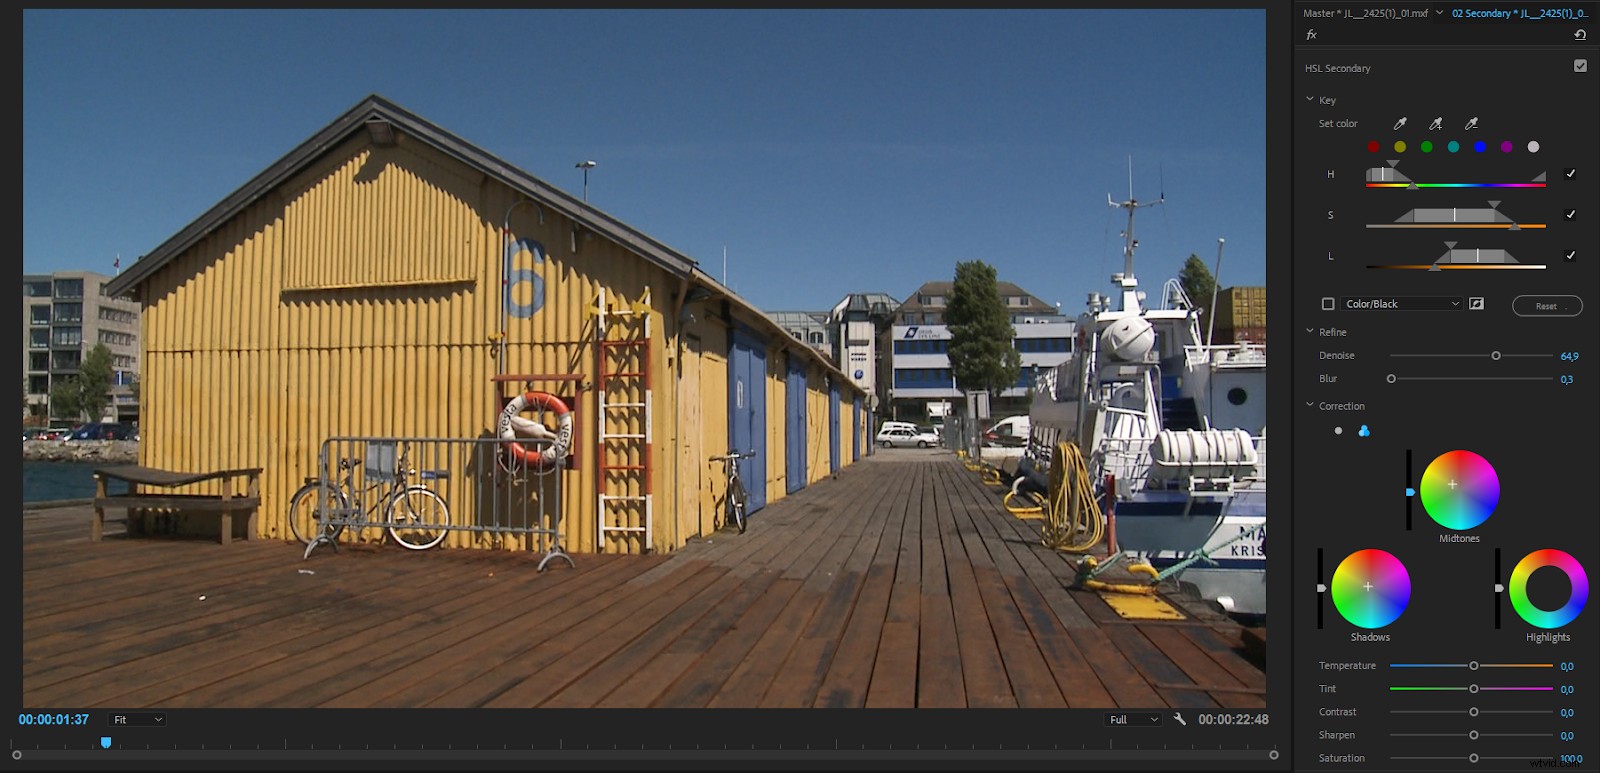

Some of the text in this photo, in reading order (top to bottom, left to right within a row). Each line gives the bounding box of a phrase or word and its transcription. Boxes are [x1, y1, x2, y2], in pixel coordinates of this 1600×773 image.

[1303, 9, 1337, 18] Master
[1451, 8, 1464, 18] 02
[1465, 8, 1512, 20] Secondary
[1304, 63, 1372, 75] HSL Secondary
[1319, 96, 1337, 107] Key
[1319, 118, 1359, 128] Set color
[1327, 169, 1335, 179] H
[1327, 210, 1334, 220] S
[1328, 251, 1334, 261] L
[507, 237, 546, 318] 6
[1346, 298, 1399, 309] Color/Black
[1536, 302, 1558, 310] Reset
[1319, 327, 1348, 337] Refine
[1319, 351, 1355, 360] Denoise
[1559, 351, 1580, 363] 64,9
[1319, 373, 1338, 383] Blur
[1559, 374, 1574, 386] 0,3
[1318, 401, 1366, 411] Correction
[557, 424, 570, 454] vest
[1439, 533, 1481, 543] Midtones
[1231, 545, 1265, 556] KRIS
[1350, 631, 1391, 642] Shadows
[1526, 631, 1571, 645] Highlights
[1318, 661, 1377, 672] Temperature
[1559, 661, 1575, 673] 0,0
[1318, 684, 1337, 693] Tint
[1559, 685, 1575, 696] 0,0
[1318, 707, 1357, 717] Contrast
[1559, 708, 1575, 719] 0,0
[17, 713, 90, 726] 00:00:01:37
[114, 715, 127, 725] Fit
[1110, 714, 1128, 725] Full
[1198, 713, 1270, 725] 00:00:22:48
[1318, 729, 1356, 741] Sharpen
[1559, 731, 1575, 742] 0,0
[1319, 753, 1366, 763] Saturation
